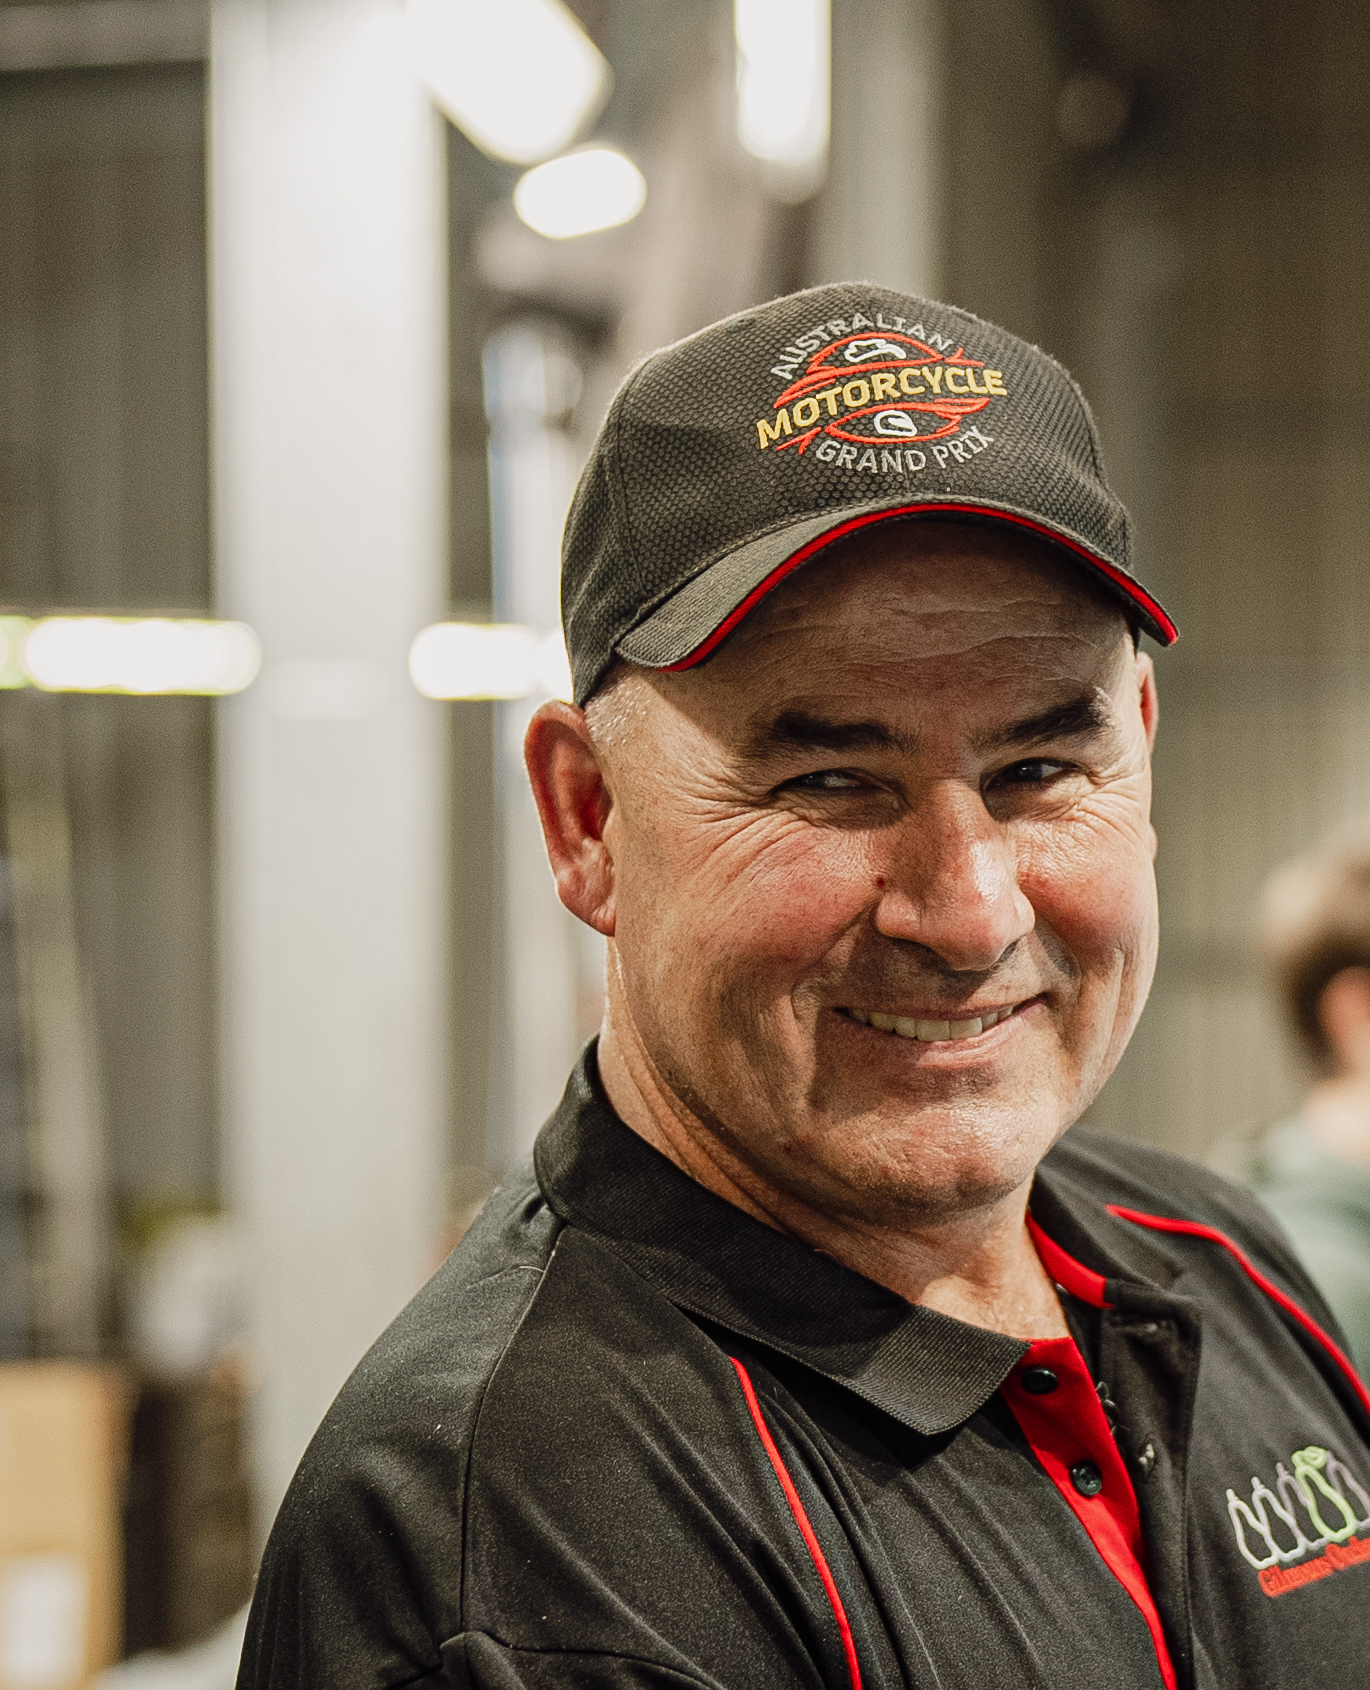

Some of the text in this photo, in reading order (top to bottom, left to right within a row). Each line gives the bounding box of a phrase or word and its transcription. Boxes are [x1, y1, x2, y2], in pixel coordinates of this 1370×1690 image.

[771, 312, 954, 380] AUSTRALIAN
[756, 366, 1008, 450] MOTORCYCLE
[816, 425, 994, 474] GRAND PRIX
